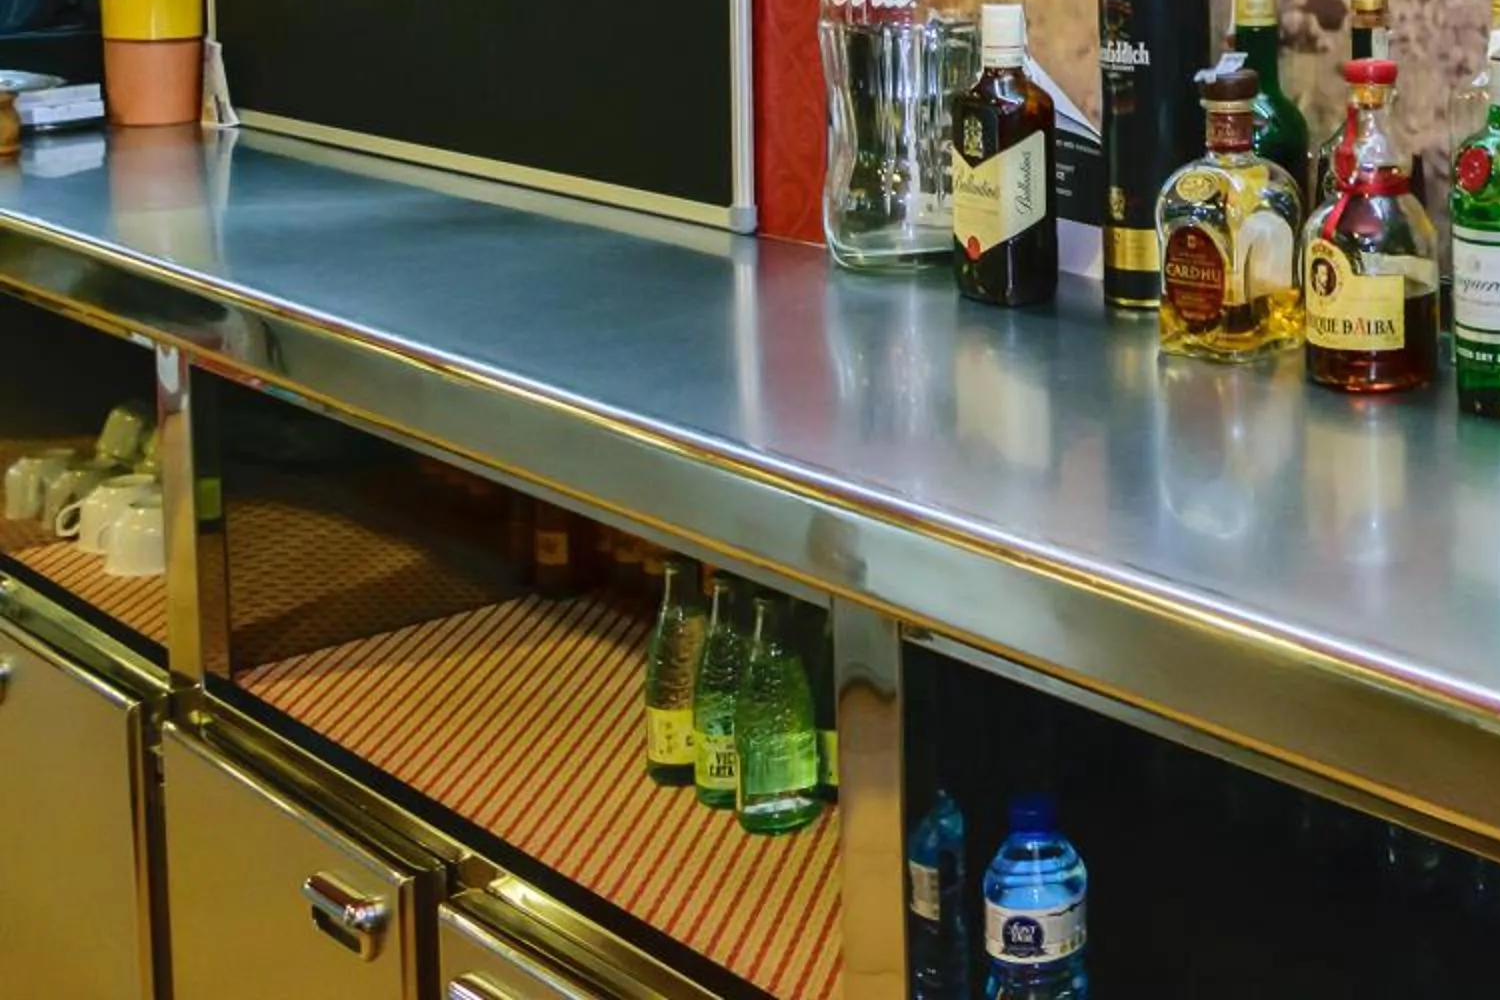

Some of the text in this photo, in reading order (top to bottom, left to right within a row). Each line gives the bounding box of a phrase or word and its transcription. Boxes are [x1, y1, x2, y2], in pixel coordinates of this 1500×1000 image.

[1165, 262, 1222, 284] CARDHU
[714, 751, 736, 765] VIC
[709, 764, 735, 777] CATA
